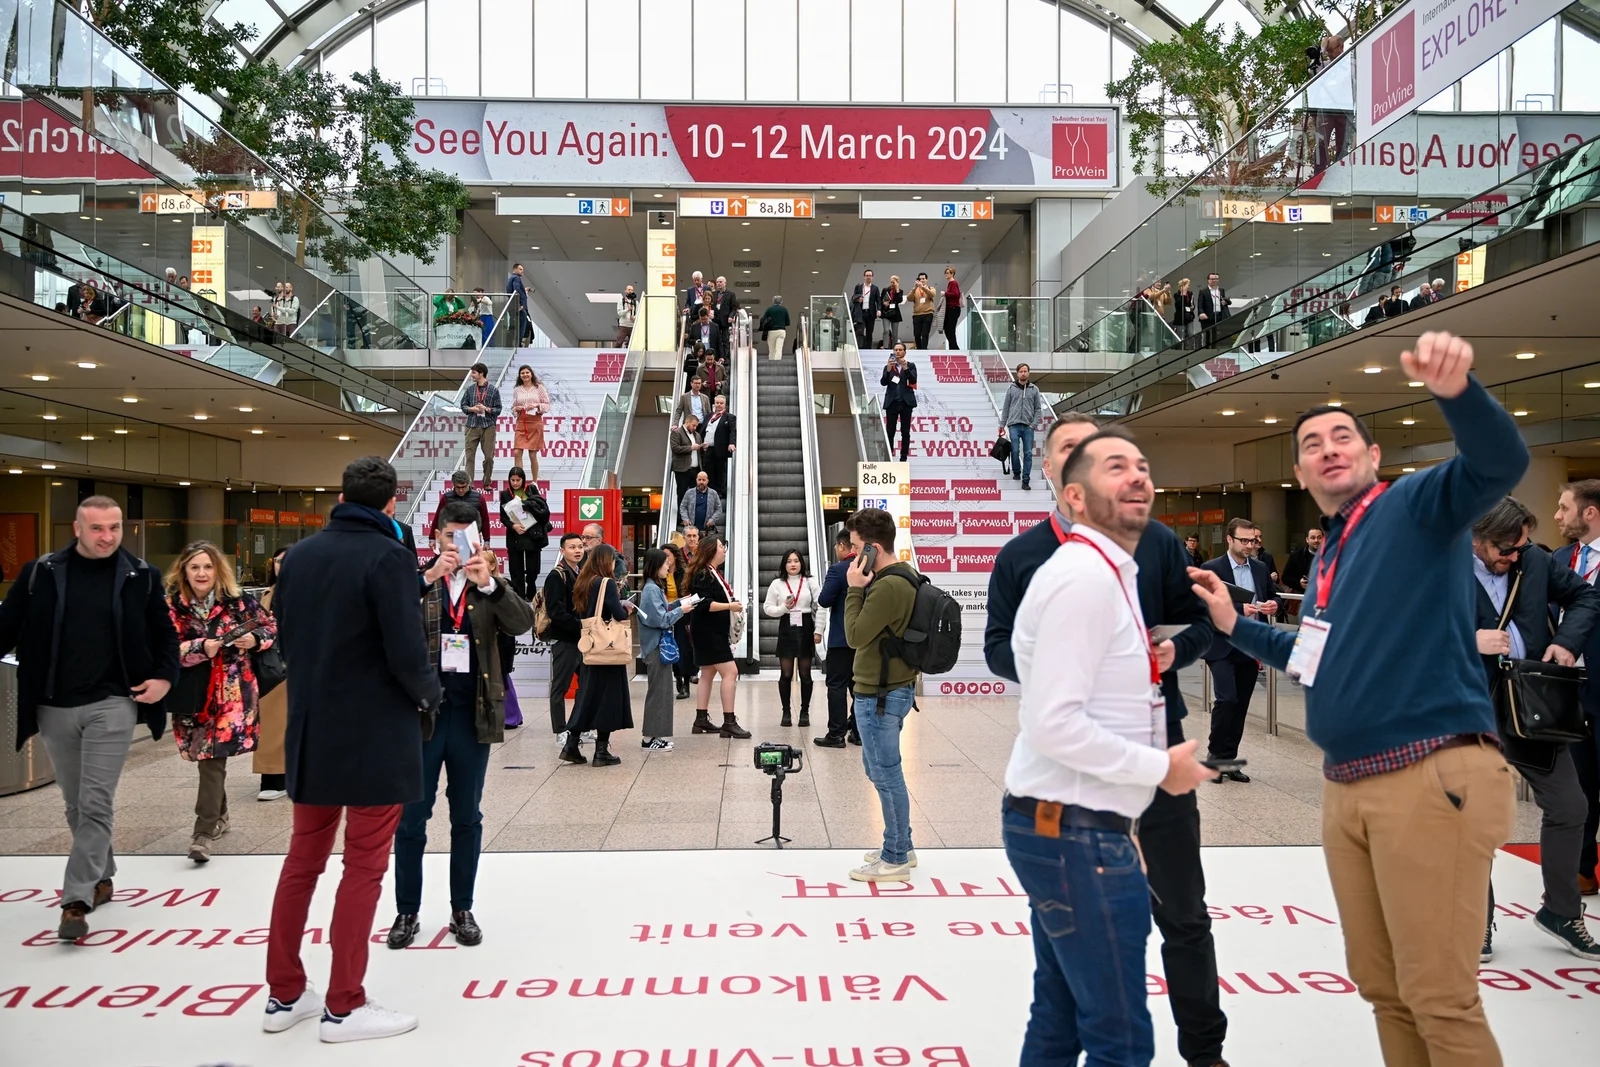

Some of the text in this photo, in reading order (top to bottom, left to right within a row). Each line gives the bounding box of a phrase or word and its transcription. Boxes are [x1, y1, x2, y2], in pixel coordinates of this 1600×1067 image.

[1373, 83, 1414, 121] ProWine
[413, 118, 481, 155] See
[485, 120, 547, 157] You
[557, 121, 668, 165] Again:
[687, 124, 723, 159] 10
[751, 124, 789, 160] 12
[800, 124, 916, 161] March
[927, 125, 1009, 161] 2024
[1054, 165, 1106, 178] ProWein
[759, 202, 792, 216] 8a,8b
[944, 416, 974, 433] TO
[862, 472, 897, 486] 8a,8b
[955, 554, 997, 564] SINGAPO
[952, 589, 972, 597] takes
[974, 590, 987, 598] you
[22, 926, 458, 953] Tevetuloa
[629, 922, 808, 945] venit
[461, 974, 949, 1002] Välkommen
